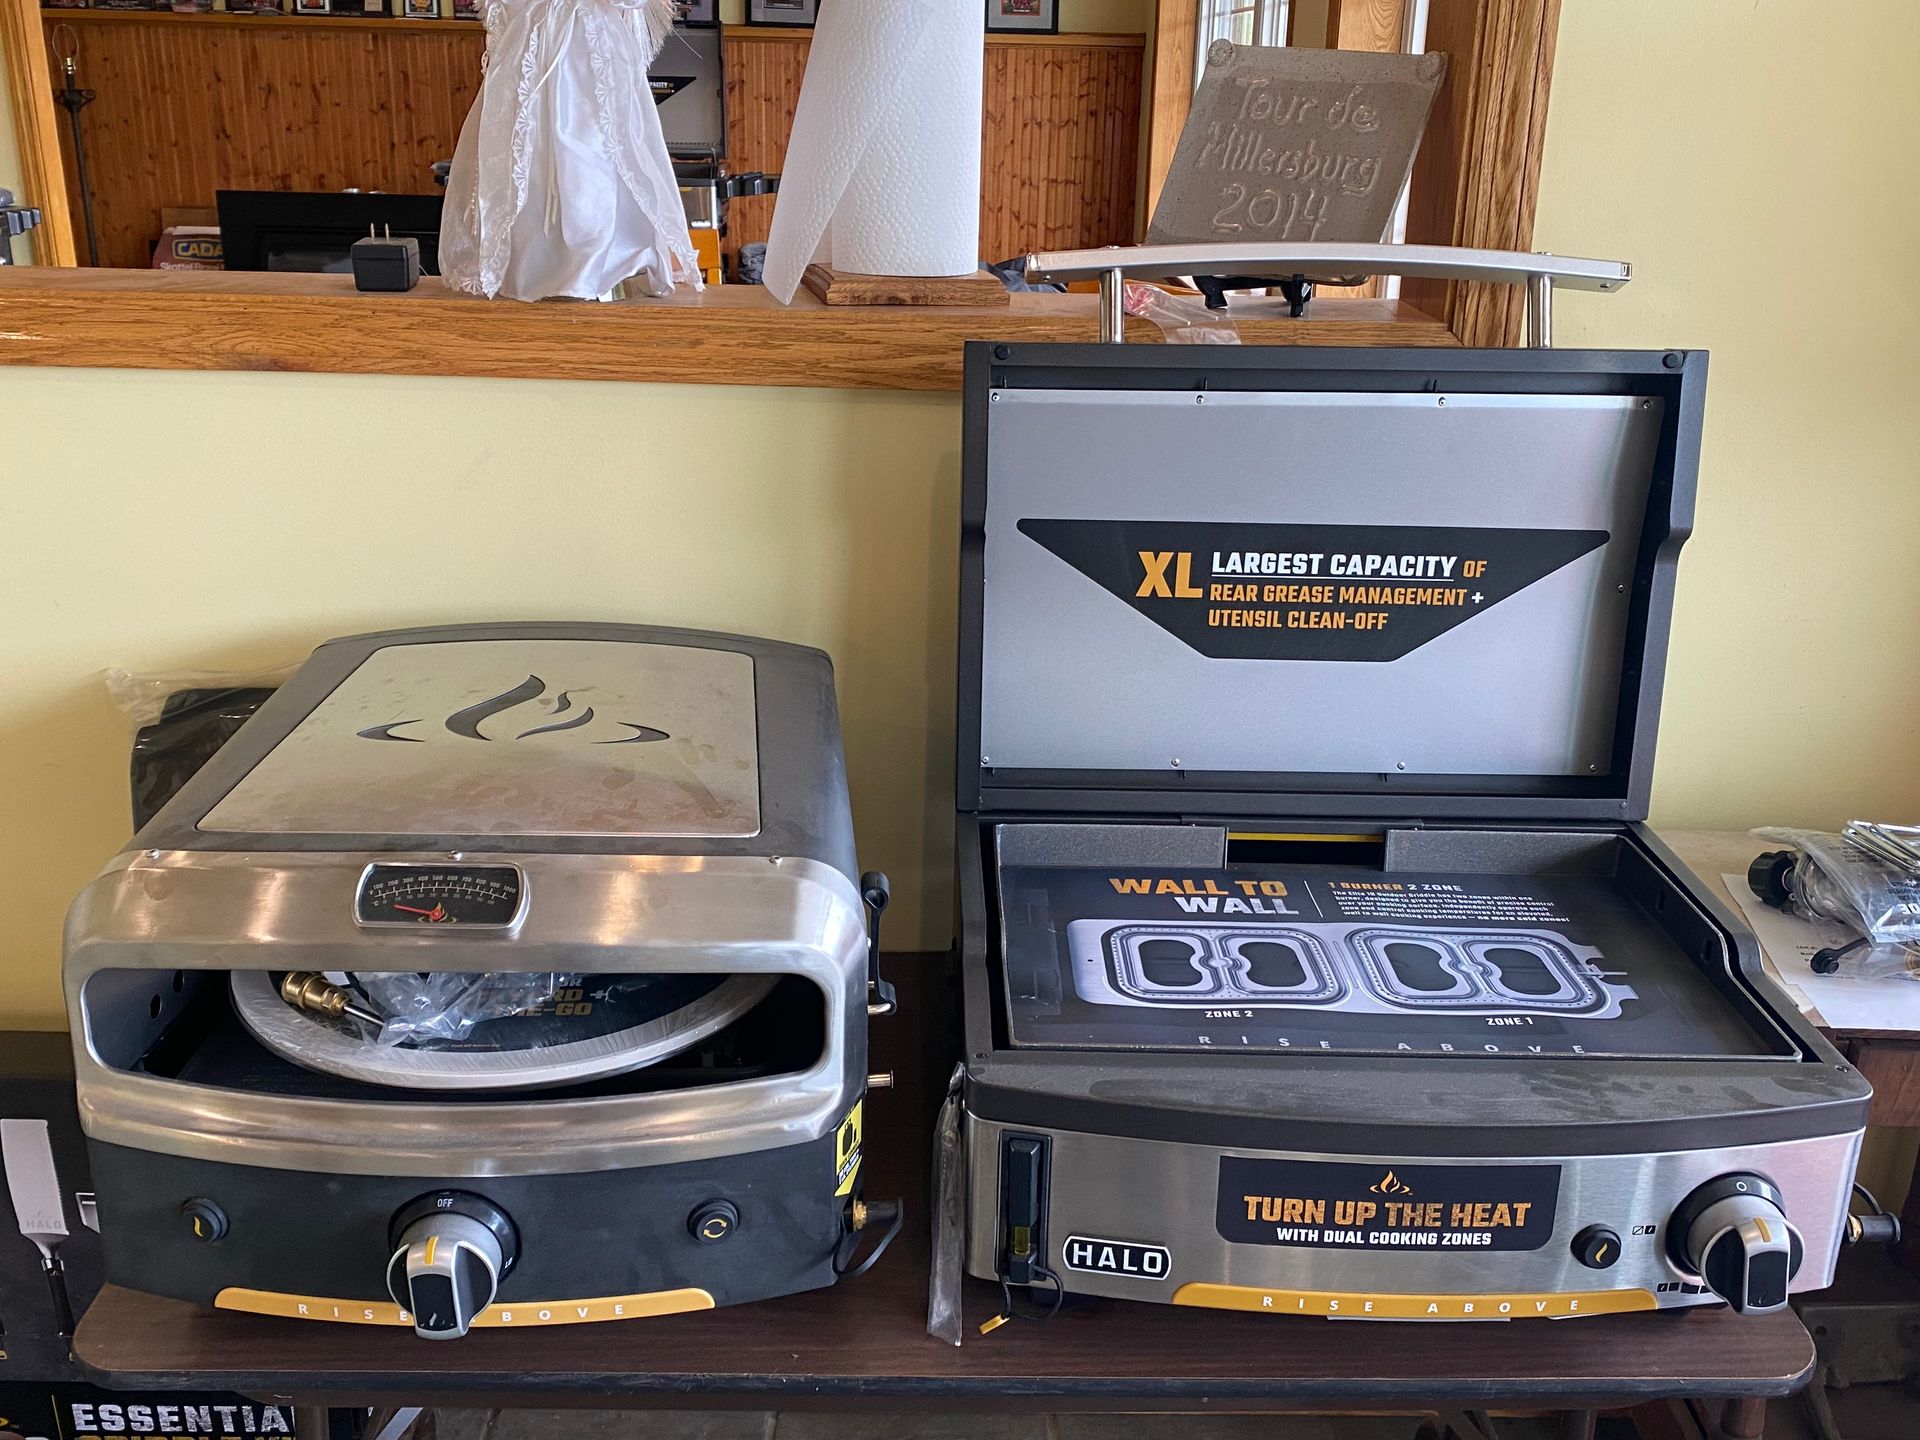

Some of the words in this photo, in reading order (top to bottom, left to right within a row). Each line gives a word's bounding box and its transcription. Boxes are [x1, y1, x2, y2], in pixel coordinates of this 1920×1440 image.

[1236, 78, 1319, 123] Tour
[1326, 84, 1381, 133] de
[1196, 118, 1383, 197] Millersburg
[1212, 183, 1330, 242] 2014
[1211, 551, 1325, 576] LARGEST
[1329, 553, 1458, 578] CAPACITY
[1463, 560, 1488, 578] OF
[1135, 551, 1203, 599] XL
[1209, 584, 1258, 602] REAR
[1262, 585, 1334, 604] GREASE
[1338, 586, 1468, 606] MANAGEMENT
[1208, 609, 1282, 628] UTENSIL
[1287, 612, 1389, 630] CLEAN-OFF
[1108, 878, 1230, 895] WALL
[1234, 880, 1288, 897] TO
[1340, 882, 1403, 891] BURNER
[1421, 884, 1463, 892] ZONE
[1174, 896, 1299, 915] WALL
[1205, 1010, 1241, 1019] ZONE
[1244, 1010, 1254, 1018] 2
[1485, 1017, 1525, 1027] ZONE
[1526, 1017, 1534, 1026] 1
[1198, 1035, 1332, 1049] RISE
[1397, 1041, 1586, 1054] ABOVE
[437, 1198, 454, 1207] OFF
[1243, 1196, 1326, 1225] TURN
[1333, 1201, 1377, 1226] UP
[1385, 1202, 1444, 1227] THE
[1450, 1202, 1532, 1228] HEAT
[26, 1220, 63, 1229] HALO
[1276, 1227, 1319, 1243] WITH
[1324, 1231, 1365, 1244] DUAL
[1369, 1231, 1438, 1245] COOKING
[1442, 1232, 1492, 1245] ZONES
[1072, 1242, 1163, 1274] HALO
[297, 1303, 408, 1322] RISE
[471, 1304, 624, 1322] BOVE
[1262, 1296, 1373, 1312] RISE
[1427, 1299, 1579, 1314] ABOVE
[71, 1403, 296, 1433] ESSENTIA
